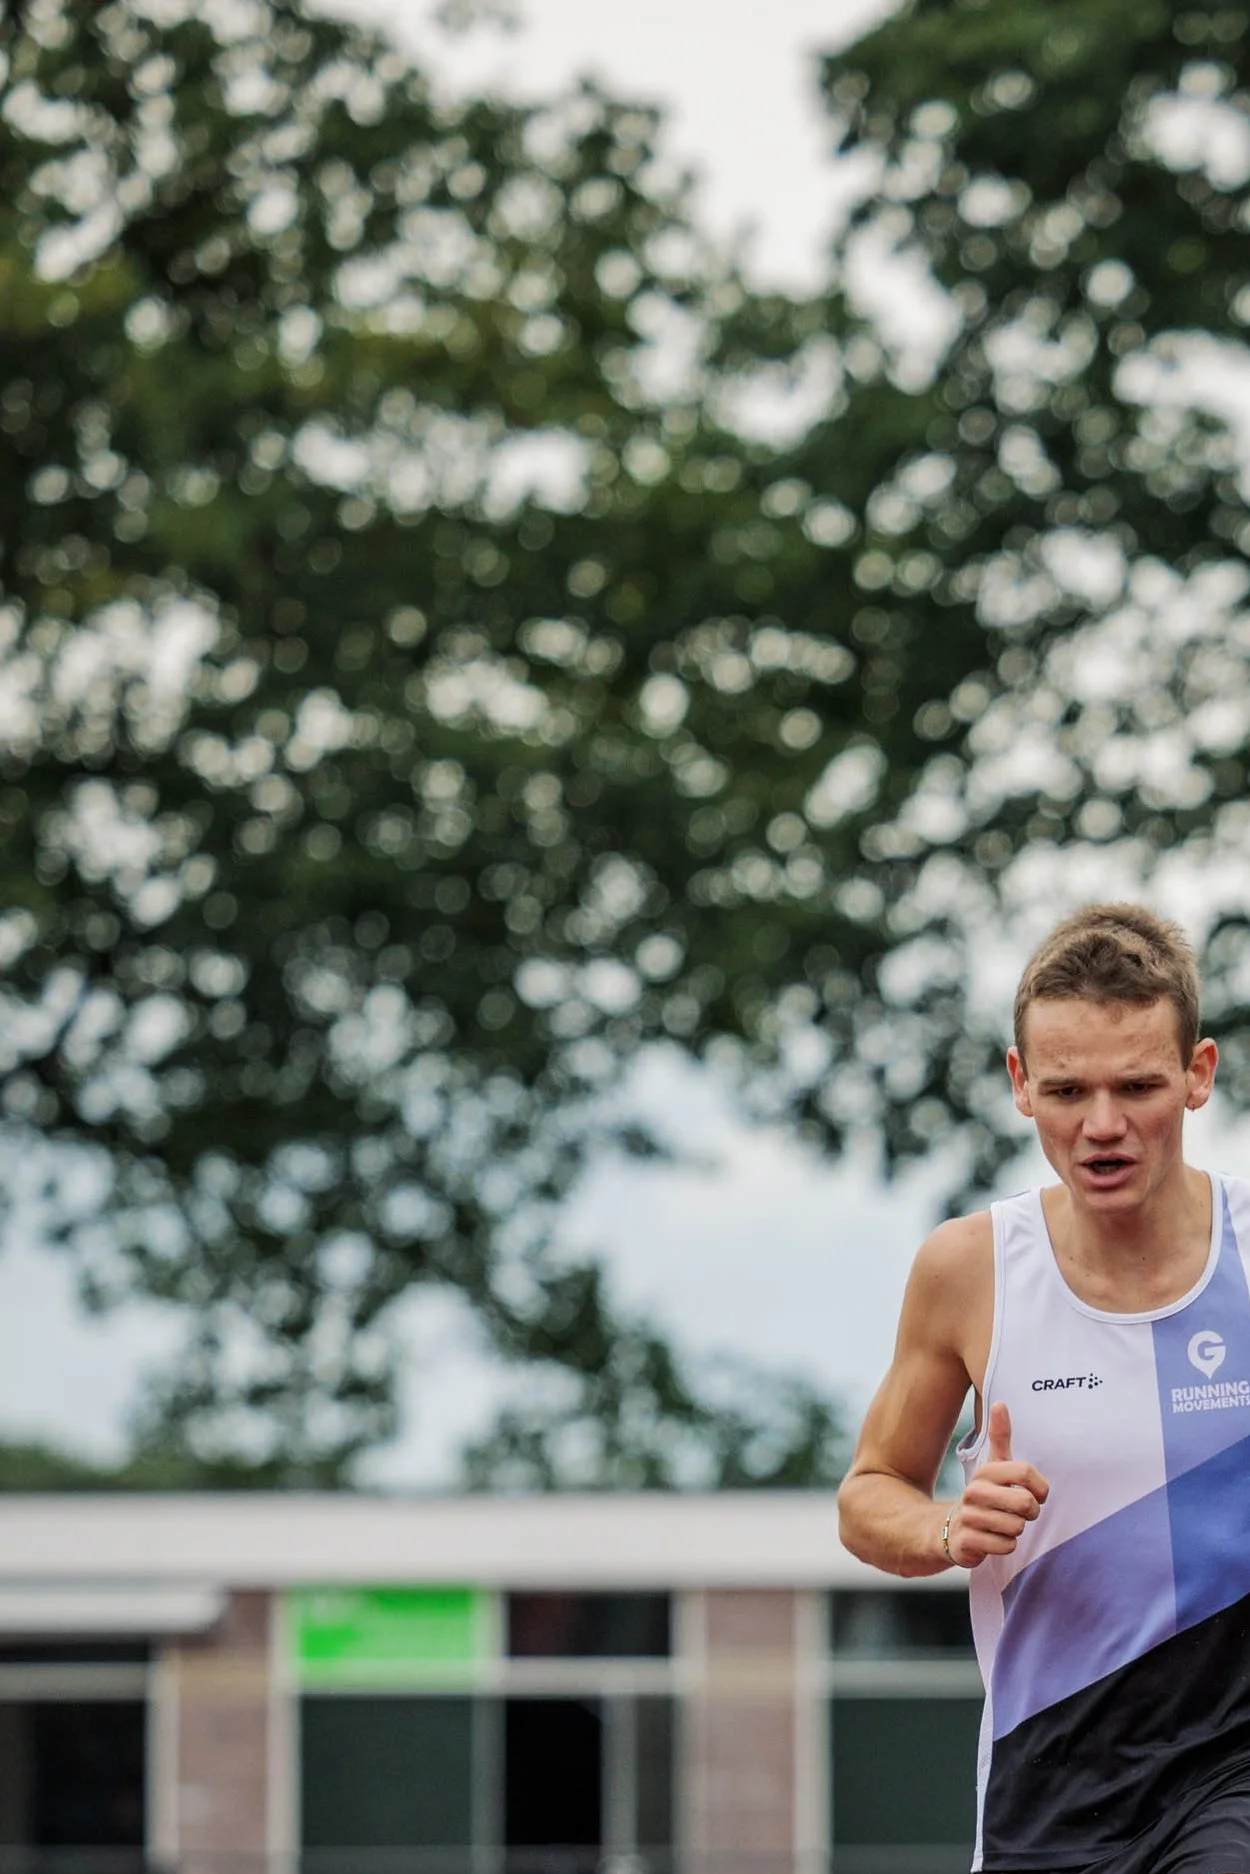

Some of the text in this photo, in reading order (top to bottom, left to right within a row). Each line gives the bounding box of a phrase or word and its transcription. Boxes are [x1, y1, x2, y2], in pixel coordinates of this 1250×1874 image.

[1187, 1330, 1226, 1380] G
[1031, 1376, 1087, 1392] CRAFT
[1171, 1380, 1250, 1402] RUNNING
